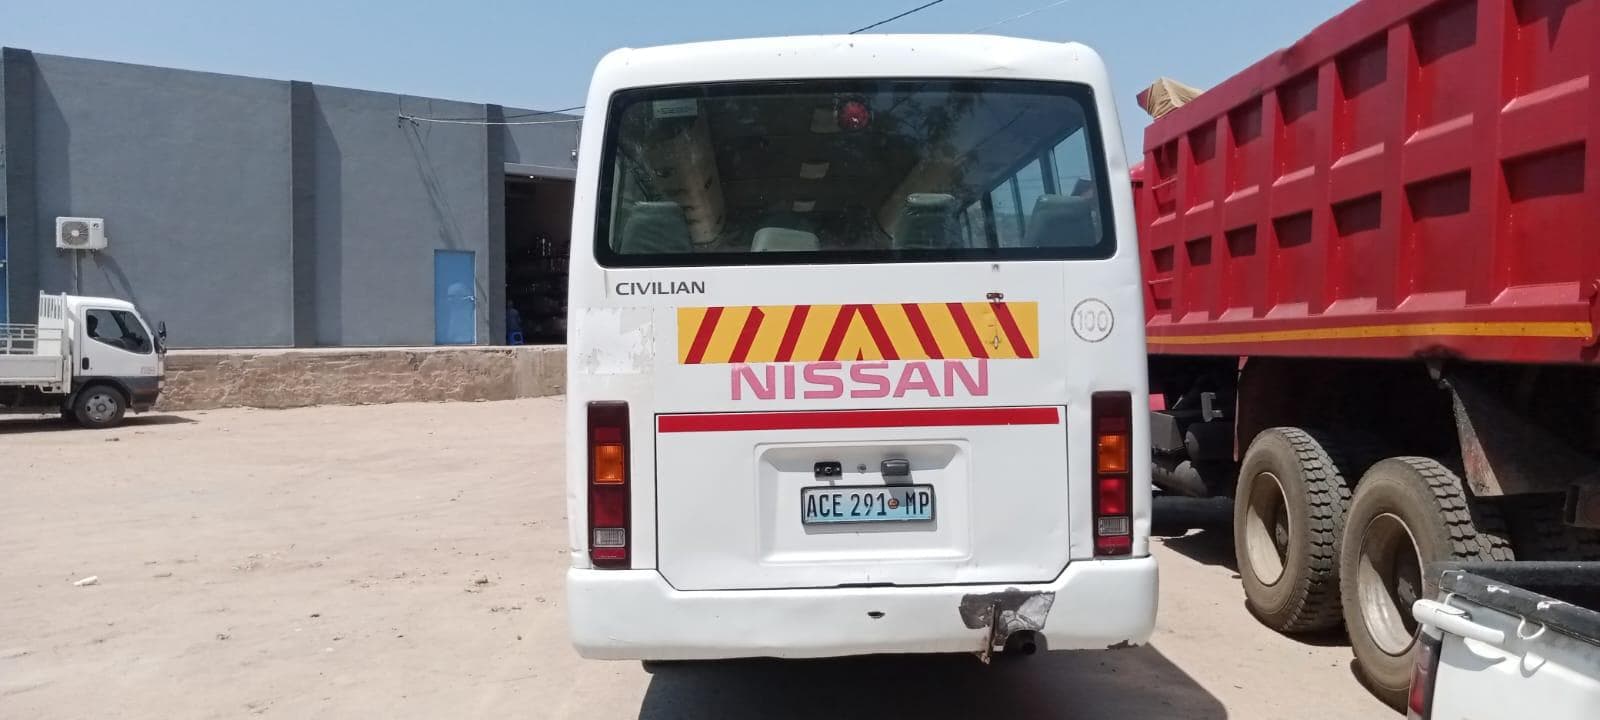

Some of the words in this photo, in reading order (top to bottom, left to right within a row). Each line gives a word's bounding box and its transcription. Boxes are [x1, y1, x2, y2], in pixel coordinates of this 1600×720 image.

[615, 281, 705, 296] CIVILIAN
[1077, 310, 1108, 332] 100
[731, 359, 989, 400] NISSAN
[806, 494, 844, 518] ACE
[850, 493, 887, 516] 291
[905, 491, 930, 515] MP
